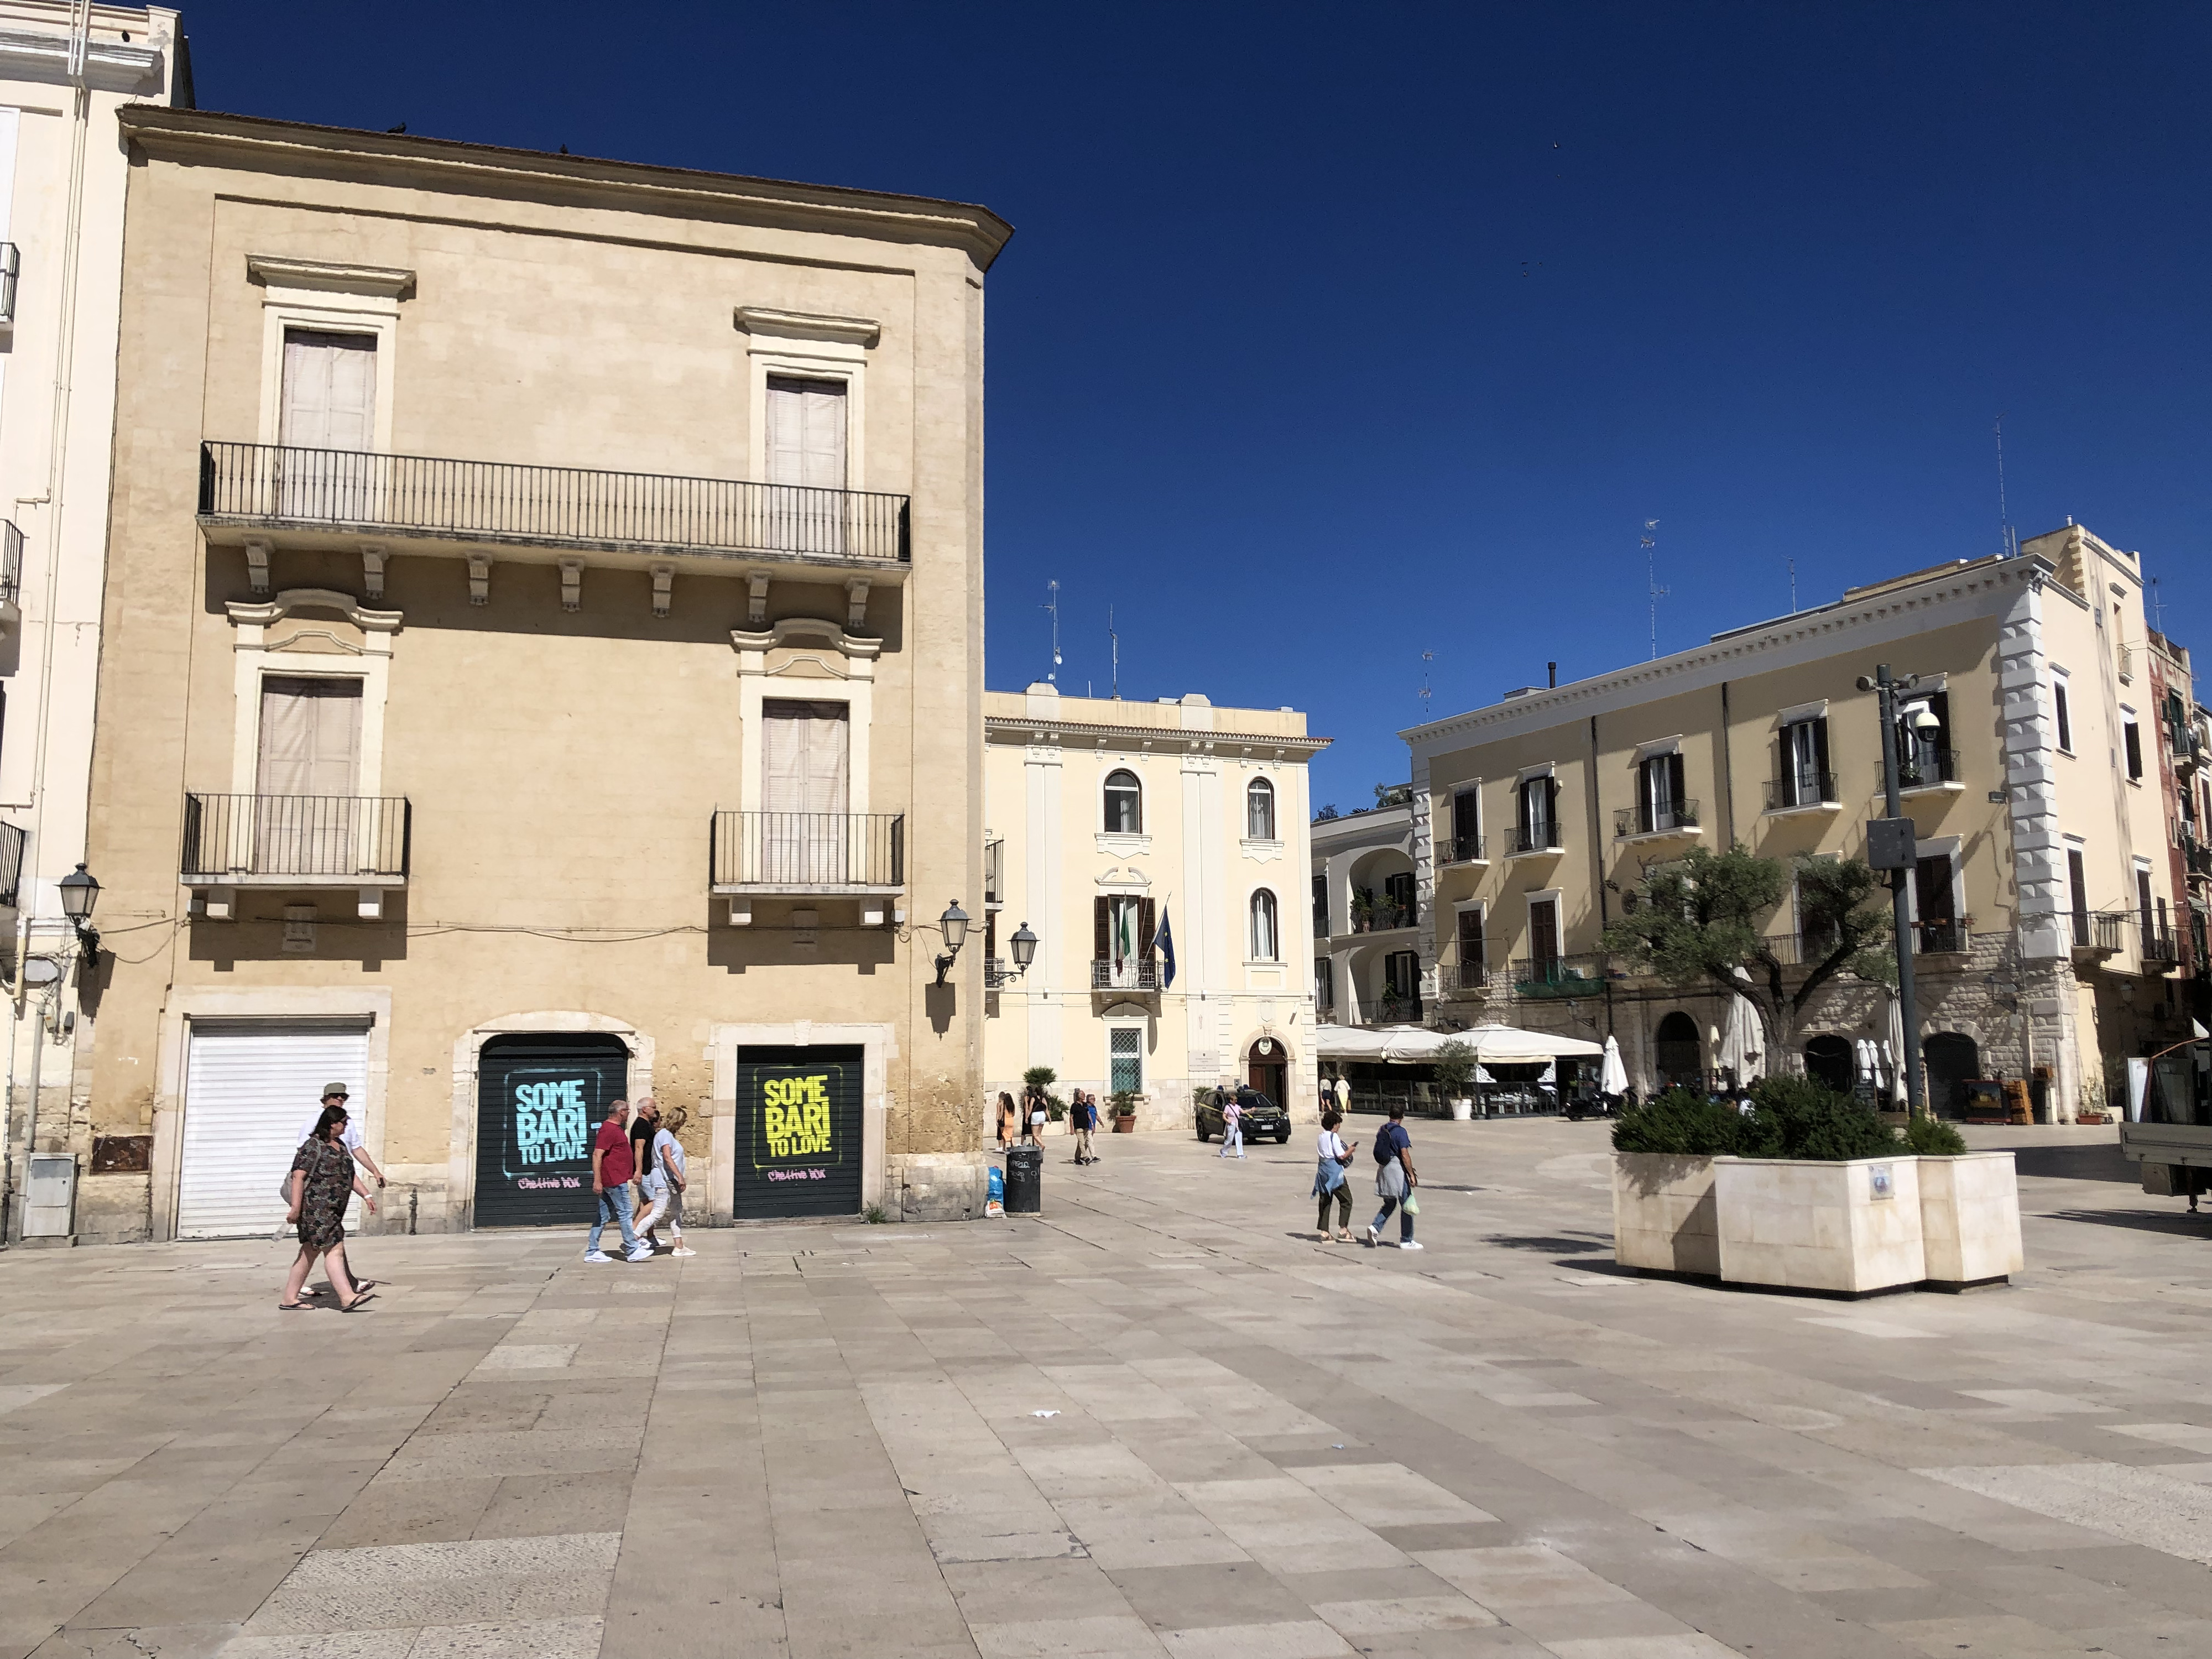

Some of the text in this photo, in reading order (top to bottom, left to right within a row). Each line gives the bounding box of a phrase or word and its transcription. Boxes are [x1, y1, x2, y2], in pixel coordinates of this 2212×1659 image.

[515, 1079, 586, 1112] SOME
[764, 1074, 830, 1106] SOME
[516, 1107, 588, 1146] BARI
[764, 1102, 831, 1143] BARI
[518, 1140, 588, 1165] TO LOVE
[767, 1135, 832, 1157] TO LOVE
